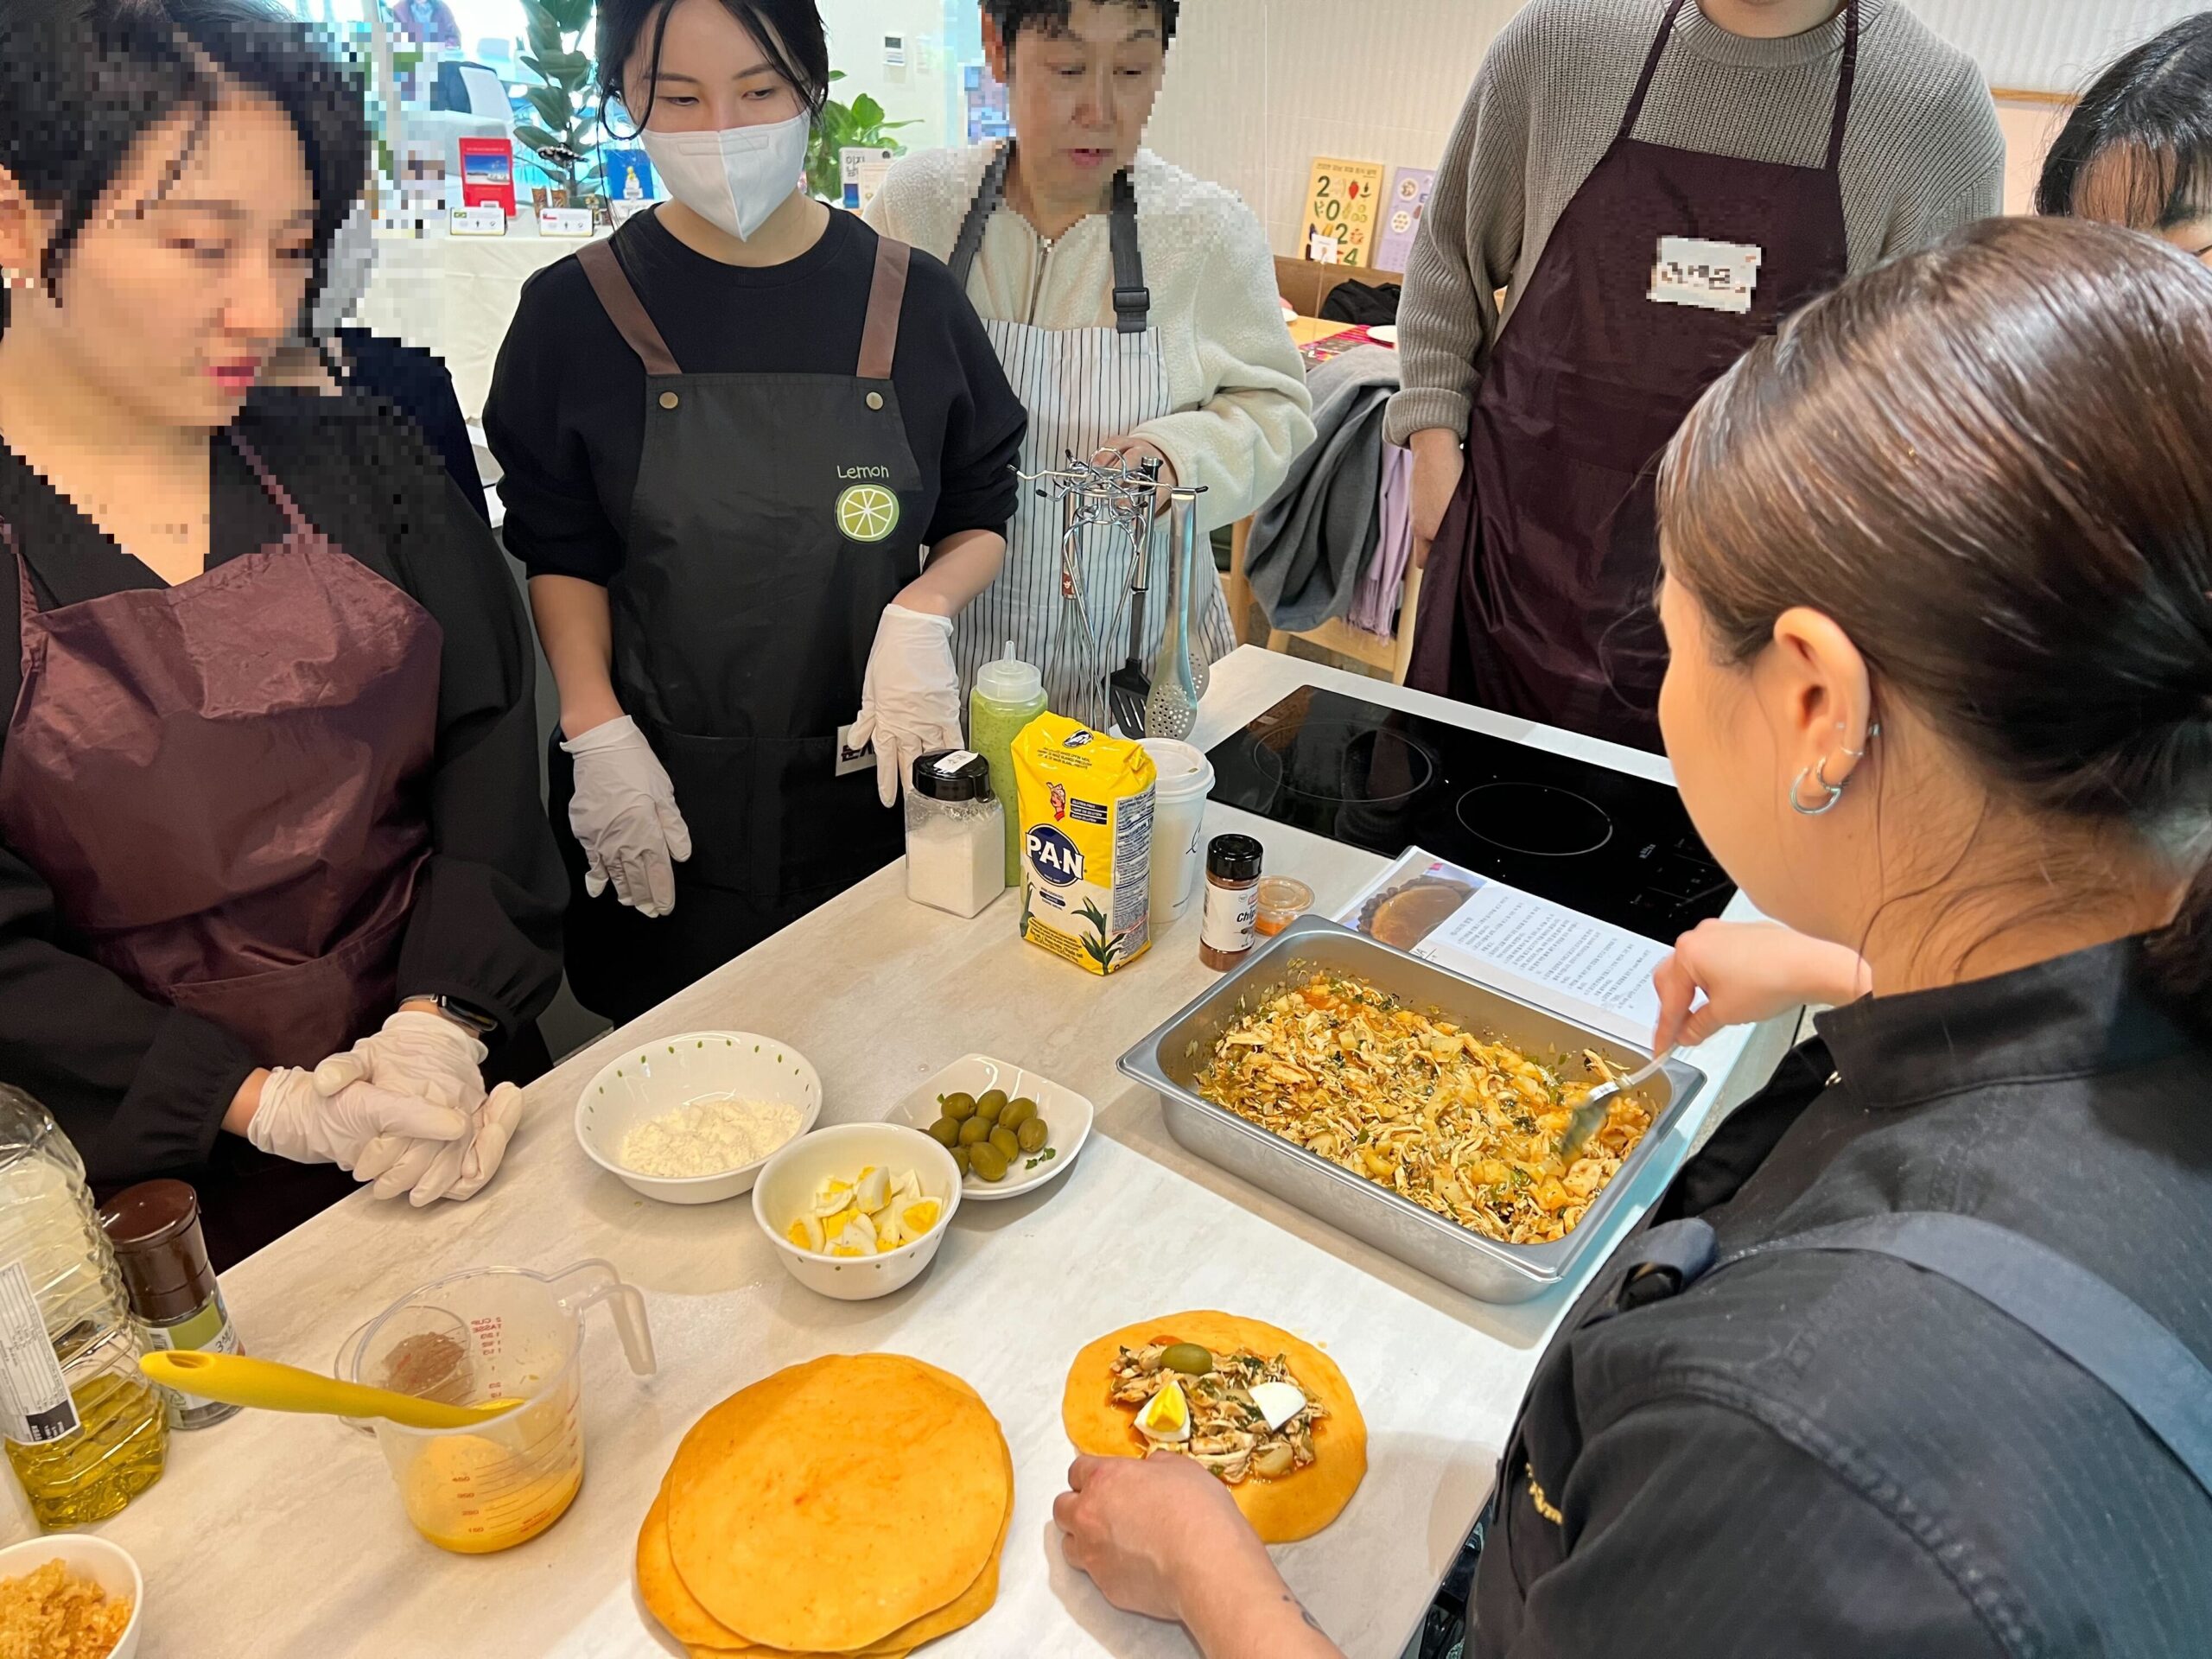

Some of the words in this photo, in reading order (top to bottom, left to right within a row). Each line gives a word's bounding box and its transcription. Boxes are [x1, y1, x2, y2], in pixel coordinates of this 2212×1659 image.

[1316, 175, 1331, 198] 2
[1325, 200, 1340, 221] 0
[1336, 223, 1348, 245] 2
[1343, 248, 1359, 266] 4
[836, 465, 889, 479] Lemon
